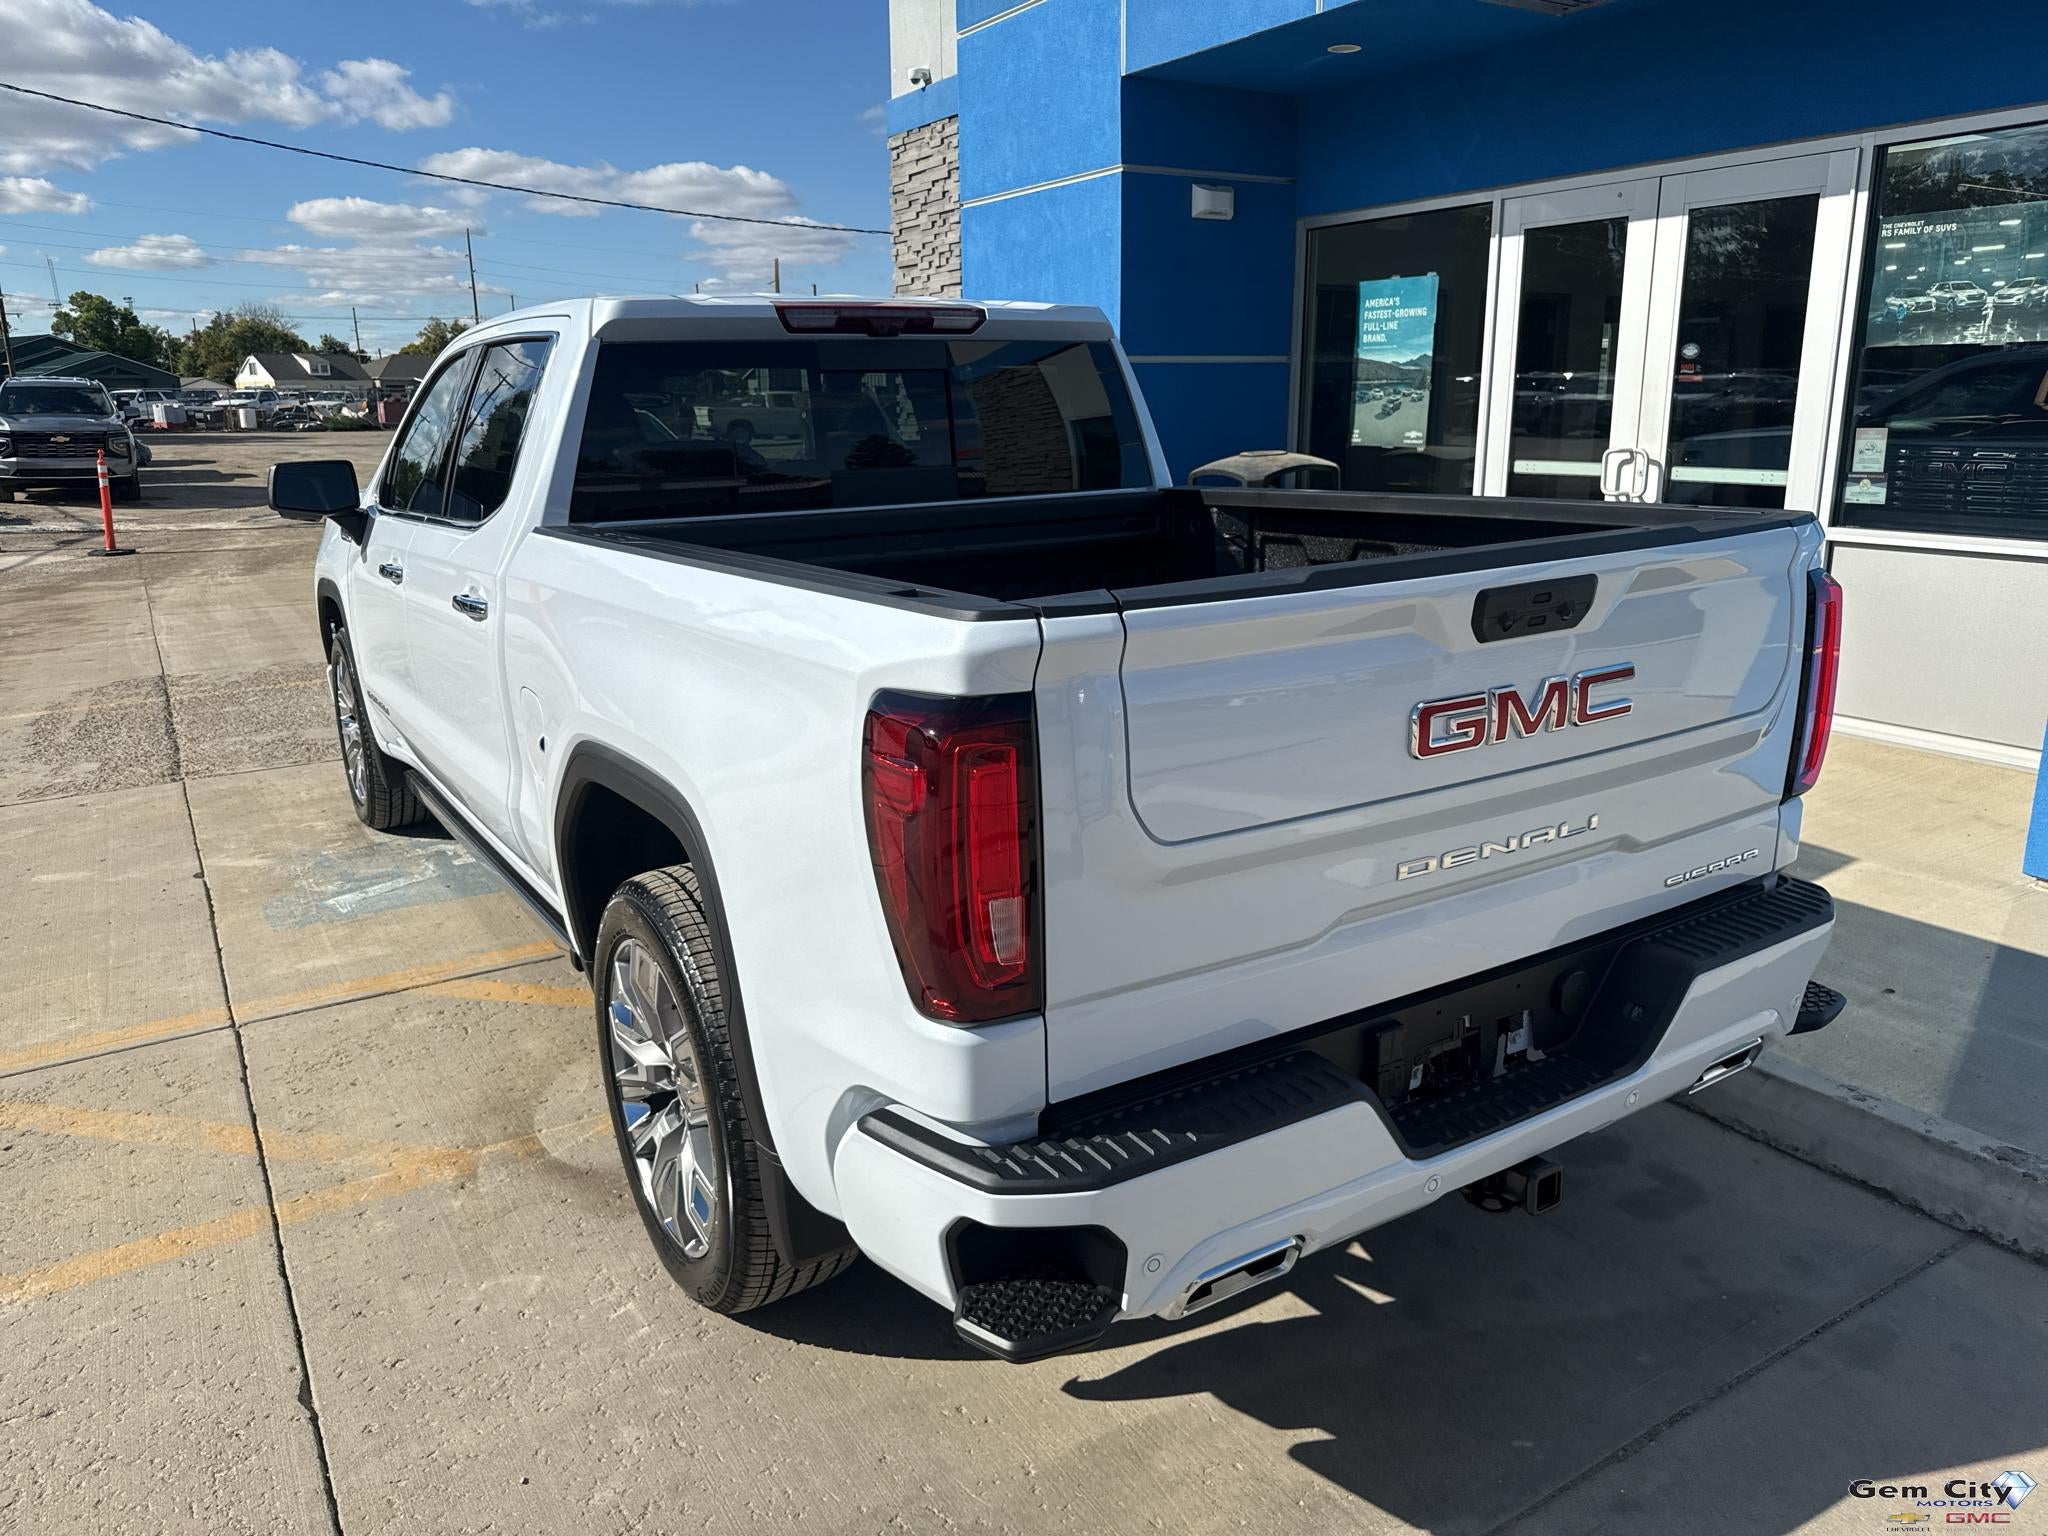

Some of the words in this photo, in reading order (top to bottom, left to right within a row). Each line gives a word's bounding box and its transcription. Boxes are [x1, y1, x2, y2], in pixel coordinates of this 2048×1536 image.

[1881, 229, 1892, 237] RS
[1893, 226, 1922, 236] FAMILY
[1924, 225, 1934, 233] OF
[1935, 223, 1957, 232] SUVS
[1365, 297, 1400, 308] AMERICA'S
[1364, 307, 1427, 320] FASTEST-GROWING
[1363, 320, 1399, 331] FULL-LINE
[1362, 333, 1388, 344] BRAND.
[1408, 661, 1636, 760] GMC
[1396, 812, 1600, 881] DENALI
[1664, 847, 1760, 888] SIERRA
